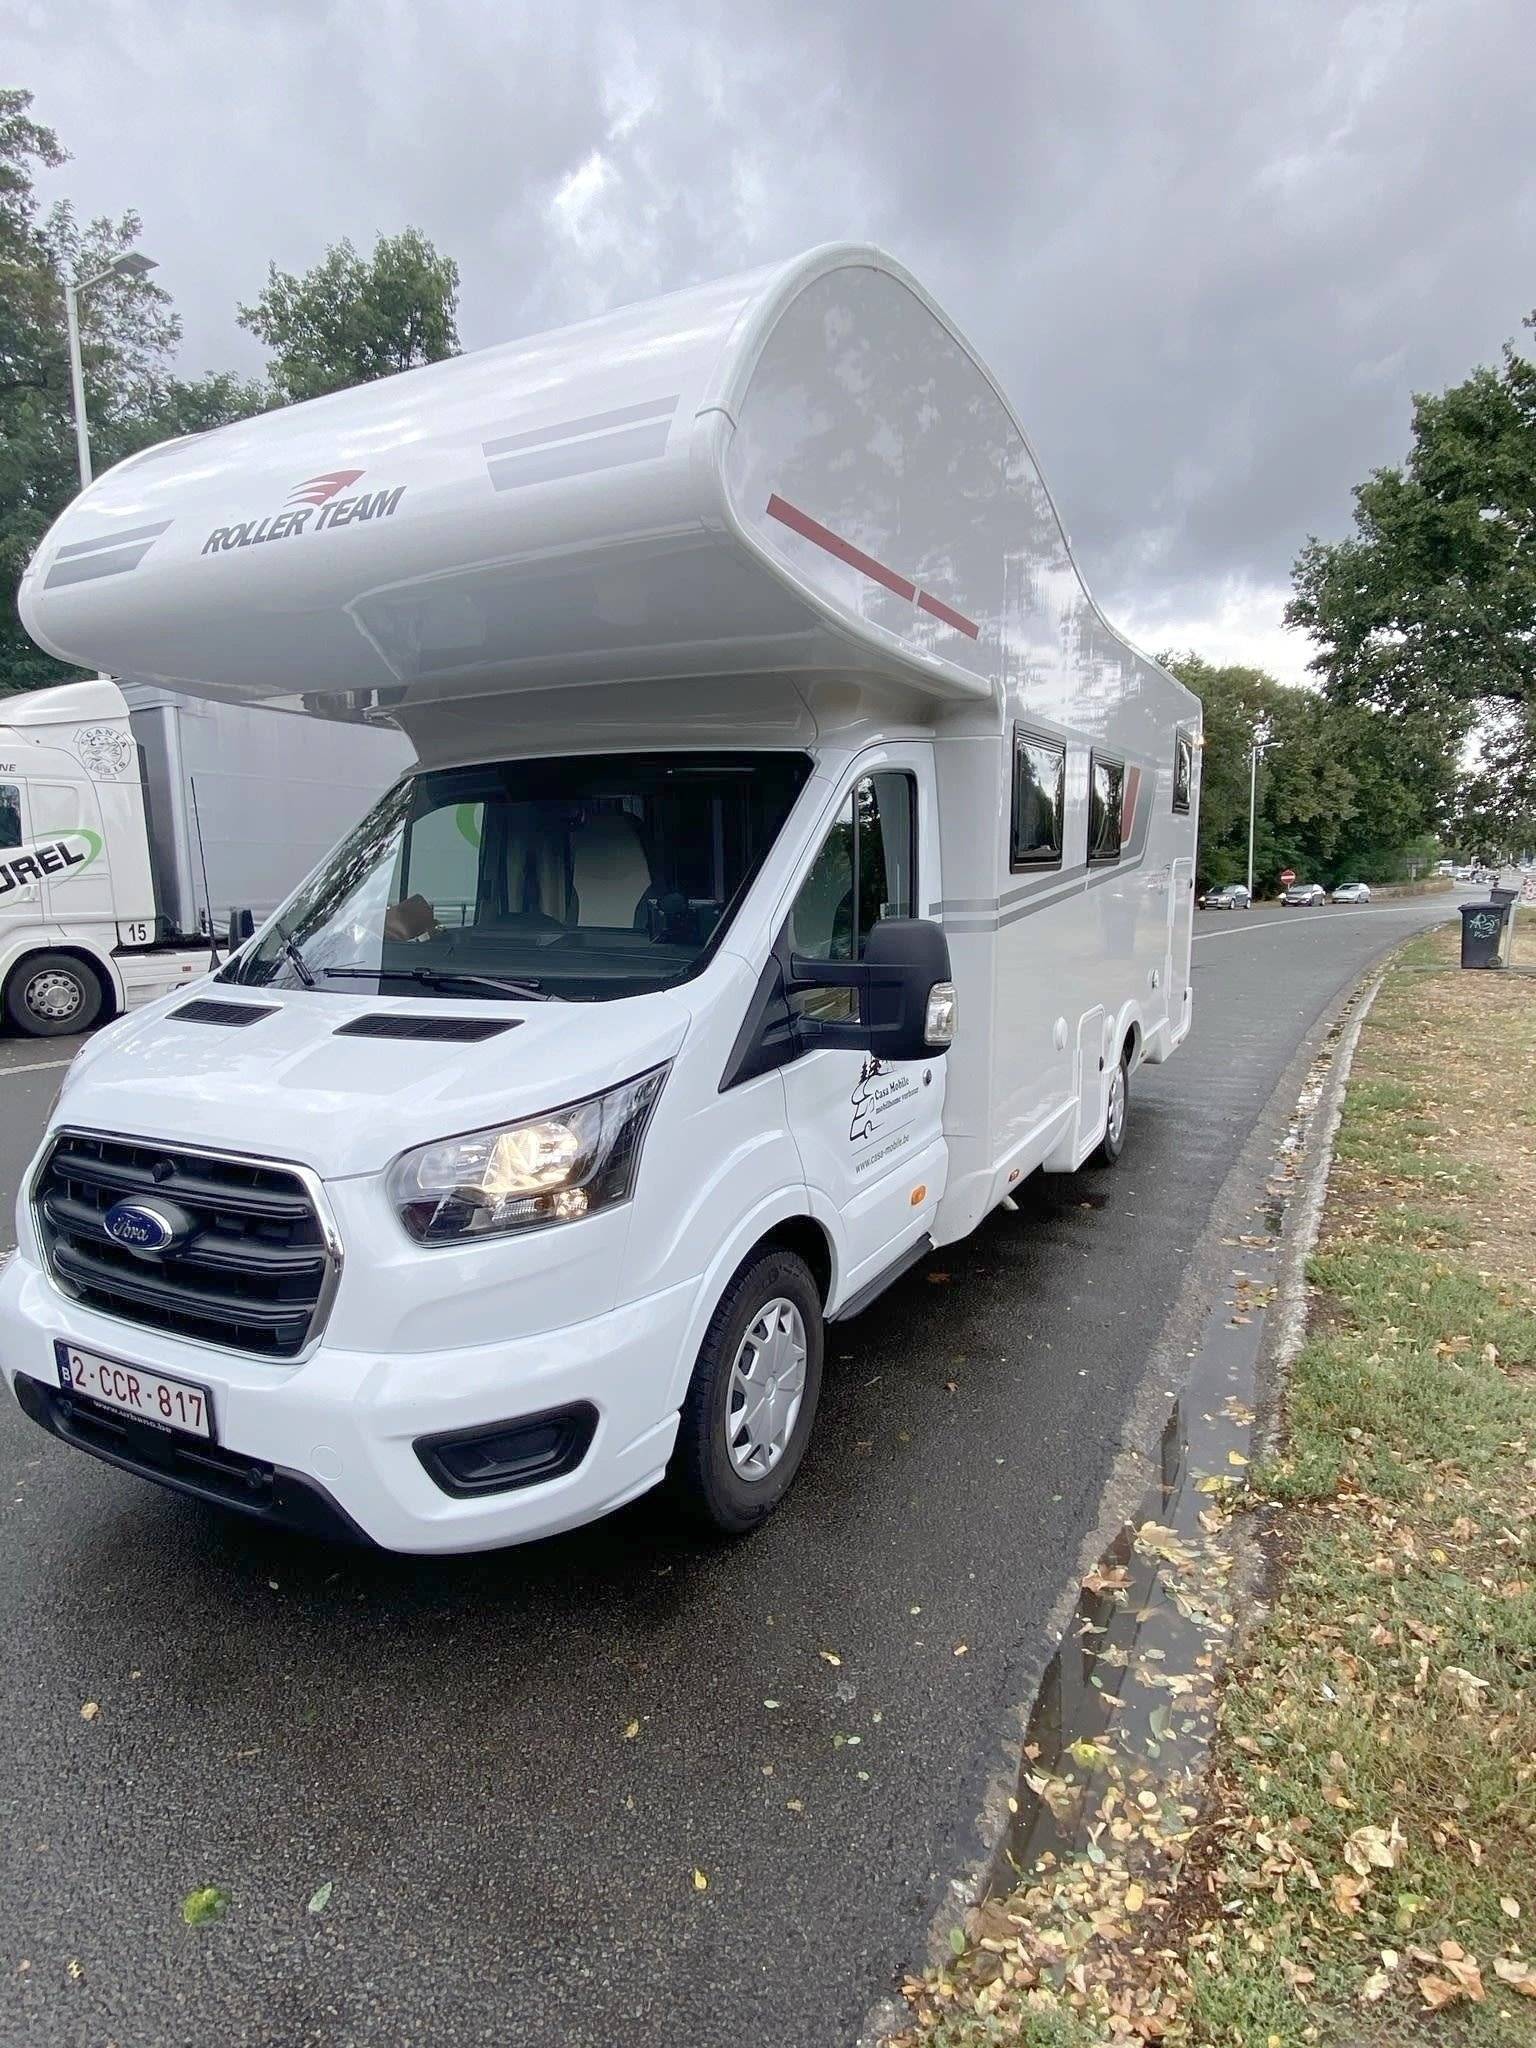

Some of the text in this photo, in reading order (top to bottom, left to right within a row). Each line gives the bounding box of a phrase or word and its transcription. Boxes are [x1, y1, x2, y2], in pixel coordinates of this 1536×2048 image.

[201, 486, 407, 555] ROLLER TEAM
[129, 923, 147, 942] 15
[875, 1076, 910, 1100] Casa Mobile
[855, 1134, 910, 1174] www.casa-mobile.be
[112, 1213, 150, 1242] Ford
[61, 1366, 71, 1382] B
